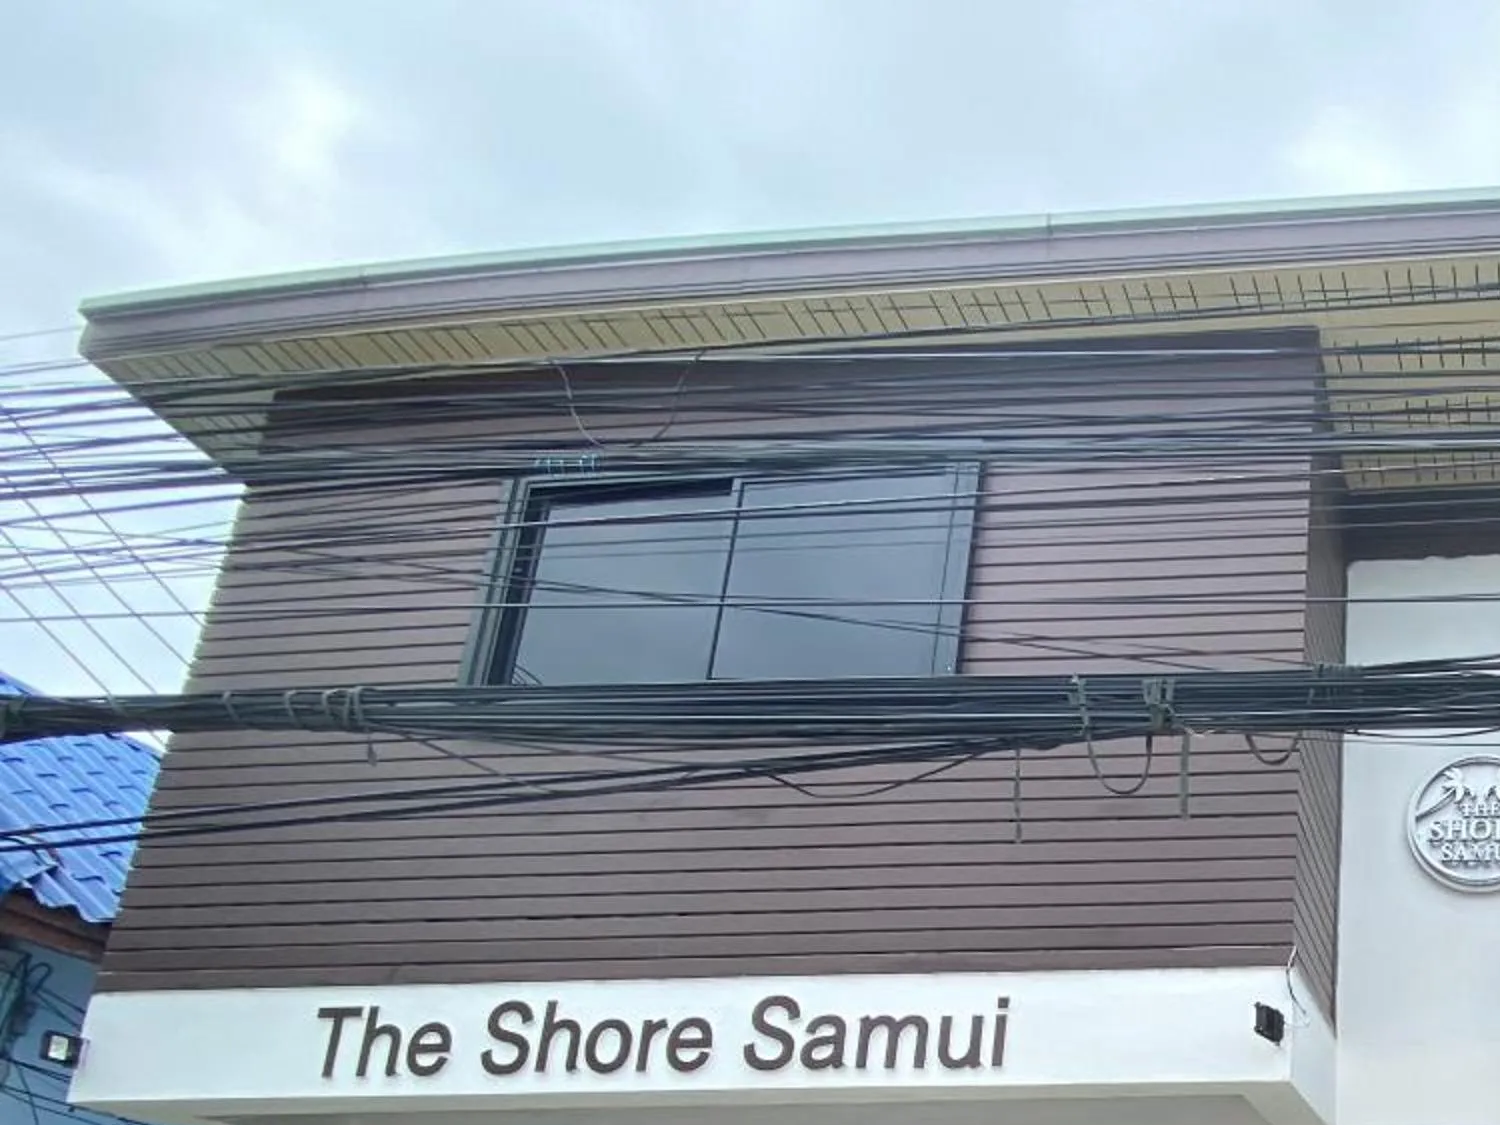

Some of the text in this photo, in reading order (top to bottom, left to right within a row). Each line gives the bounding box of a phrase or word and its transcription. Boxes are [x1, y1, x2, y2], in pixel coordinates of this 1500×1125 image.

[1460, 801, 1500, 817] THE
[317, 995, 1010, 1079] The Shore Samui
